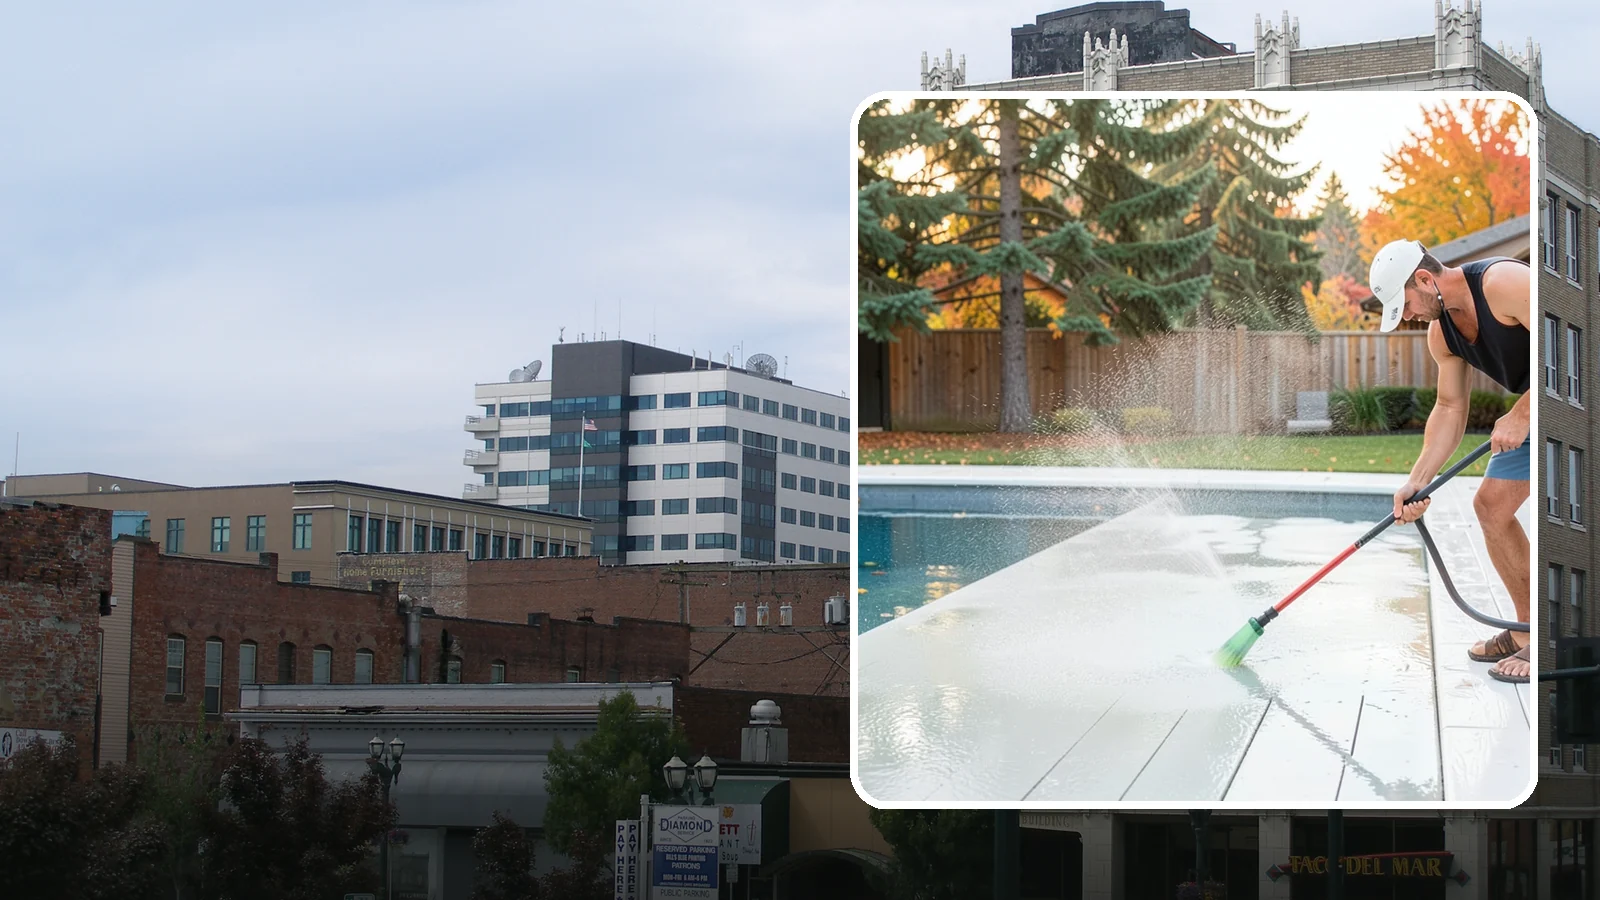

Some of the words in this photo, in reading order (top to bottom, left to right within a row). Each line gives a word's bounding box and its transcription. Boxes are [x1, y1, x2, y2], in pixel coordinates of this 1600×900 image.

[370, 566, 428, 576] Furnishers
[660, 818, 713, 832] DIAMOND
[1022, 815, 1070, 828] BUILDING
[617, 825, 625, 852] PAY
[628, 824, 636, 852] PAY
[656, 845, 688, 853] RESERVED
[690, 846, 716, 854] PARKING
[721, 851, 739, 862] Soup
[671, 862, 701, 870] PATRONS
[1346, 856, 1384, 876] DEL
[1392, 857, 1442, 877] MAR
[616, 856, 625, 893] HERE
[627, 855, 636, 893] HERE
[660, 889, 682, 898] PUBLIC
[683, 889, 710, 898] PARKING
